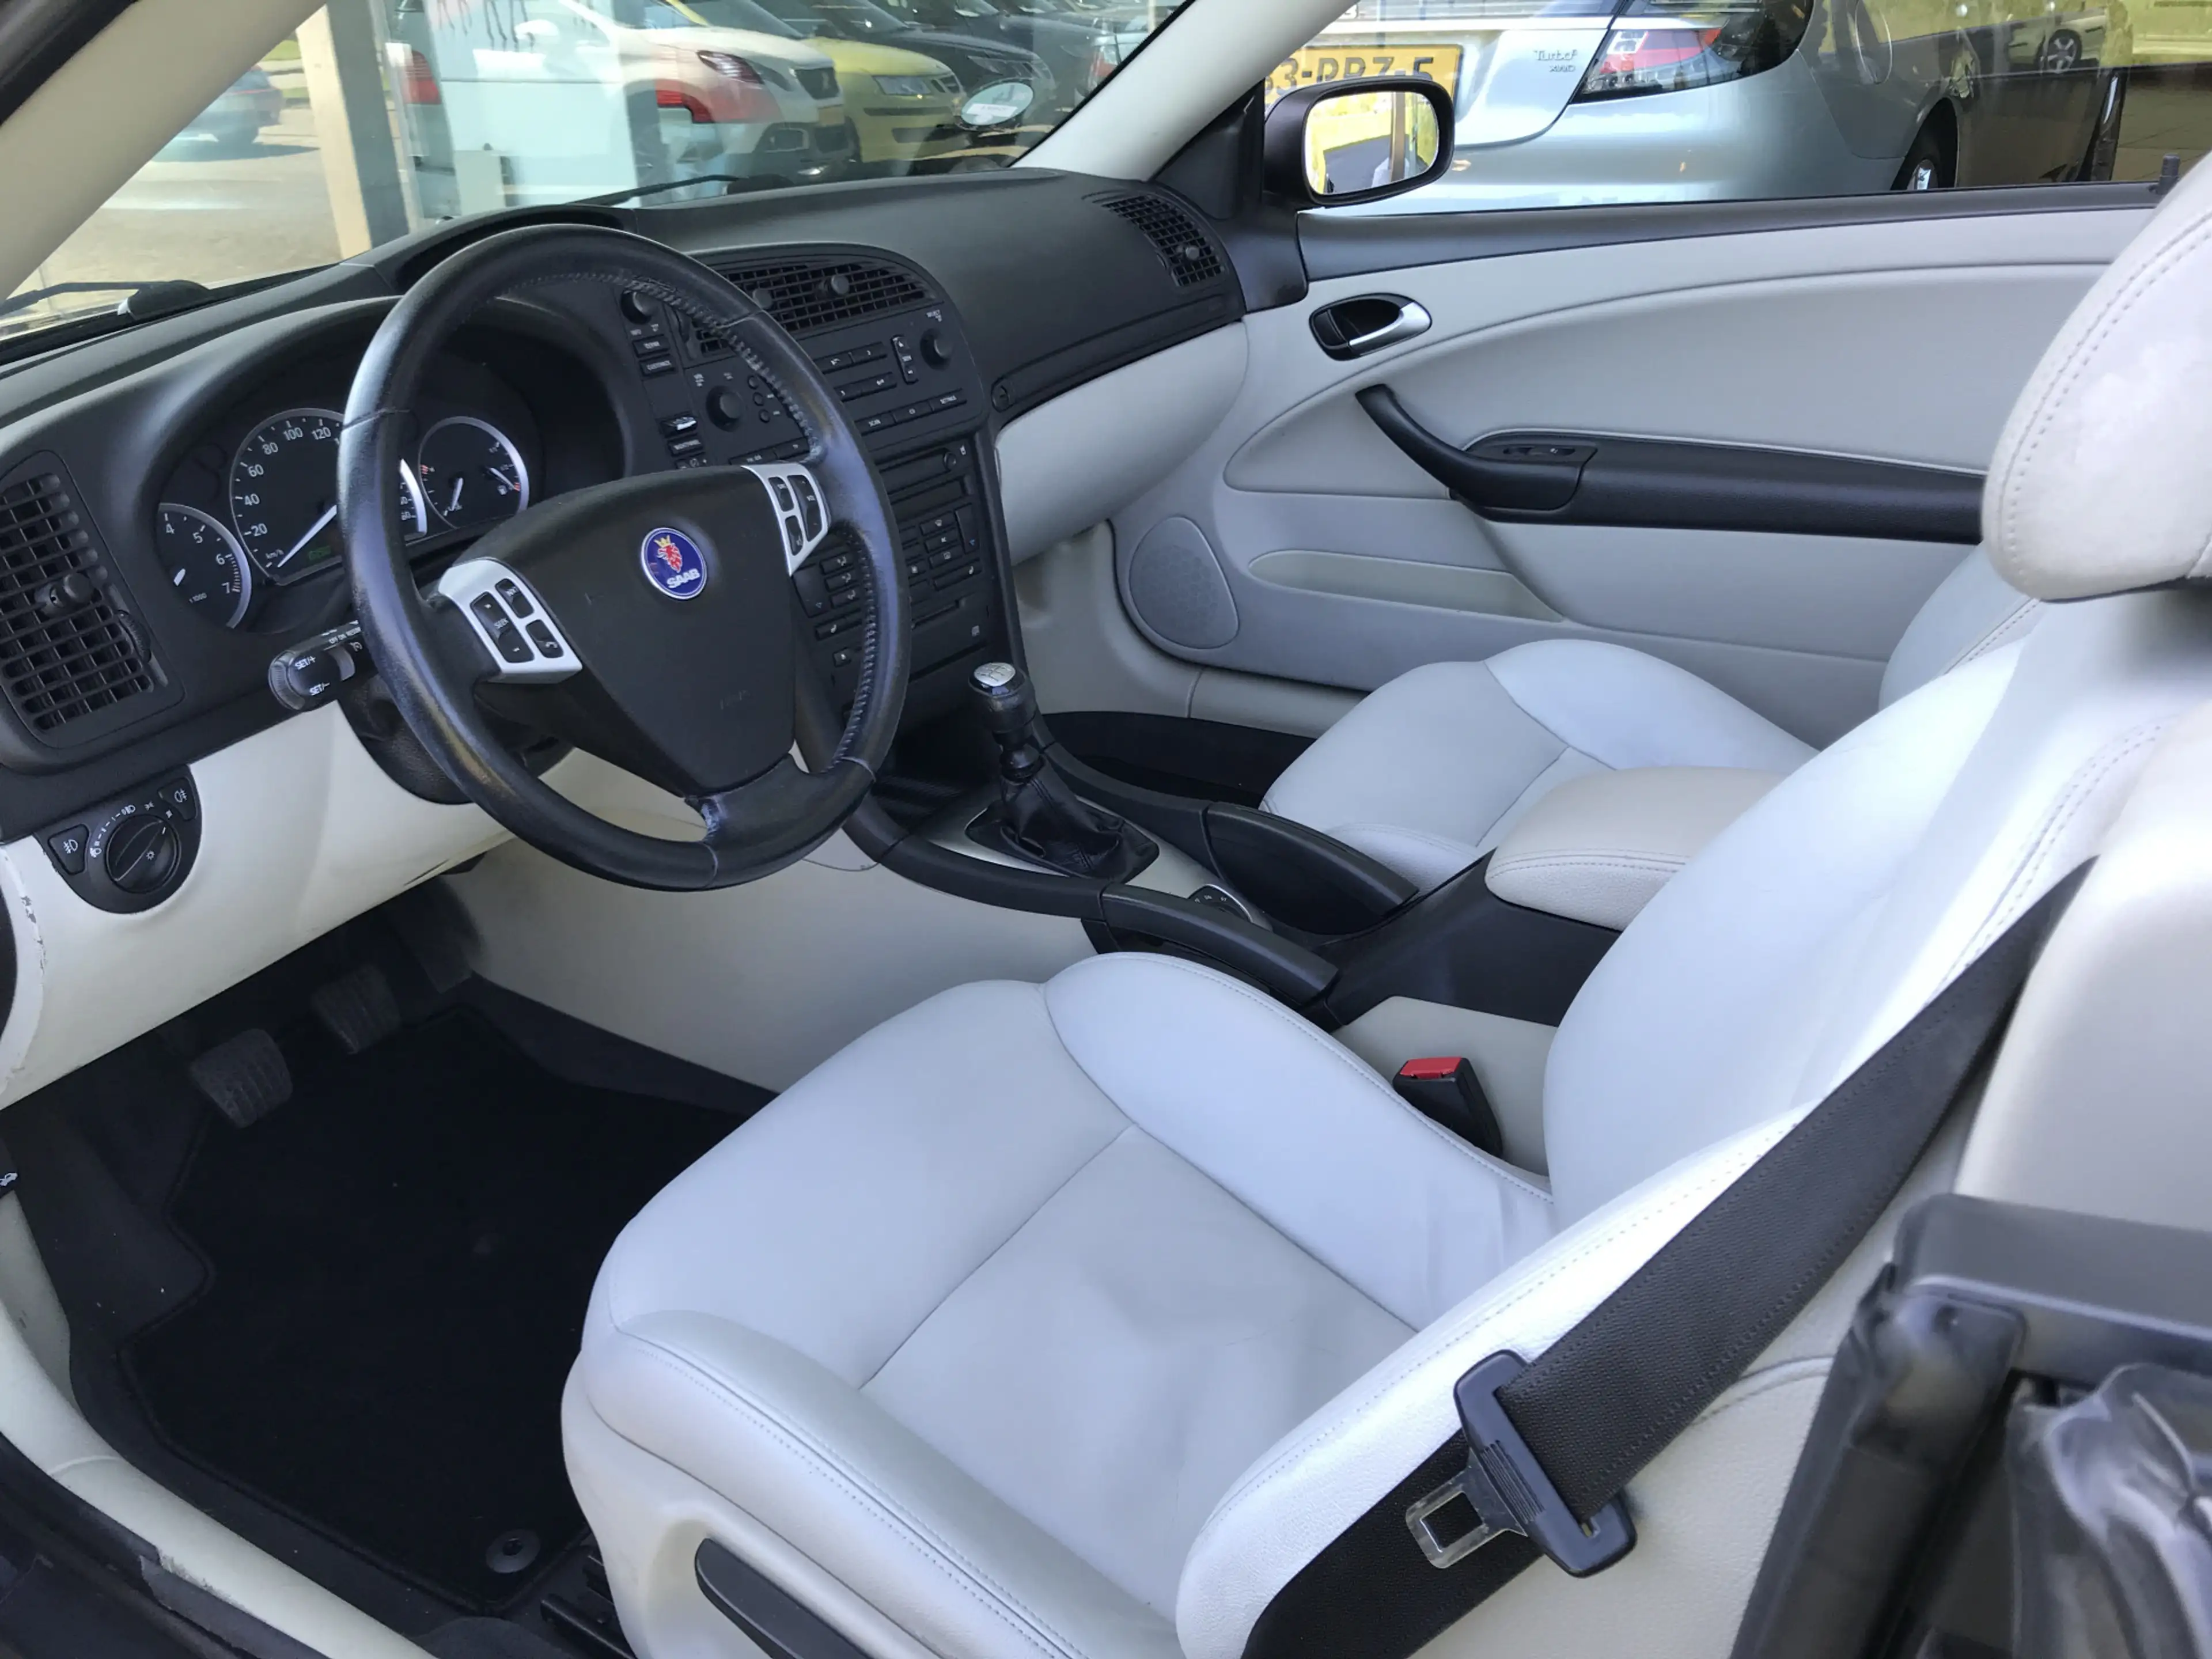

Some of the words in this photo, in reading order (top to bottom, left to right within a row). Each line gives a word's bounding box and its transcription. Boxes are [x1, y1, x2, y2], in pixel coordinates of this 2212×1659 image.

[283, 427, 303, 441] 100
[312, 427, 331, 440] 120
[262, 442, 279, 455] 80
[247, 464, 264, 478] 60
[244, 494, 260, 505] 40
[165, 524, 175, 534] 4
[251, 523, 268, 537] 20
[192, 532, 203, 544] 5
[215, 554, 225, 565] 6
[666, 568, 700, 589] SAAB
[221, 582, 230, 594] 7
